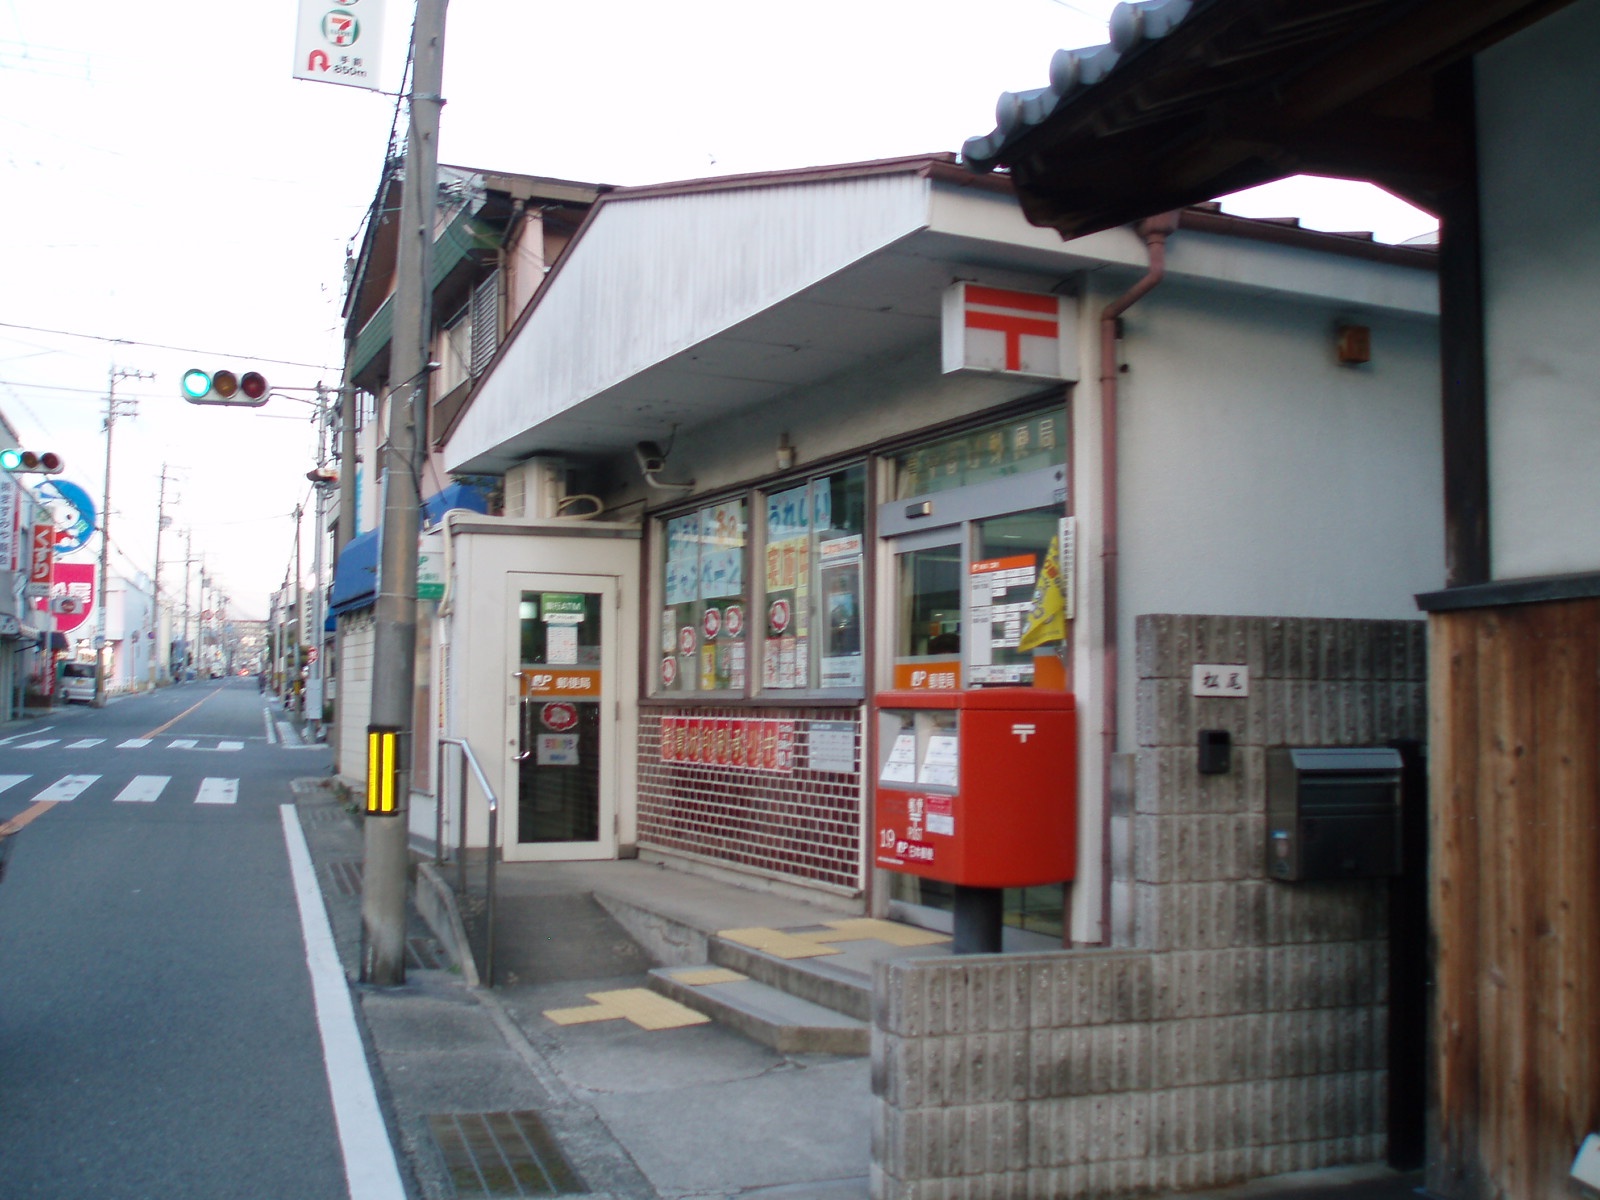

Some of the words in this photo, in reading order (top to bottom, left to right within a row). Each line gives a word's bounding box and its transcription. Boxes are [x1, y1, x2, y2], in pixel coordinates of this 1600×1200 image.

[33, 528, 52, 579] くすり
[556, 676, 591, 689] 郵便局
[928, 672, 955, 689] 郵便局
[1203, 671, 1243, 690] 松尾
[880, 828, 896, 848] 19
